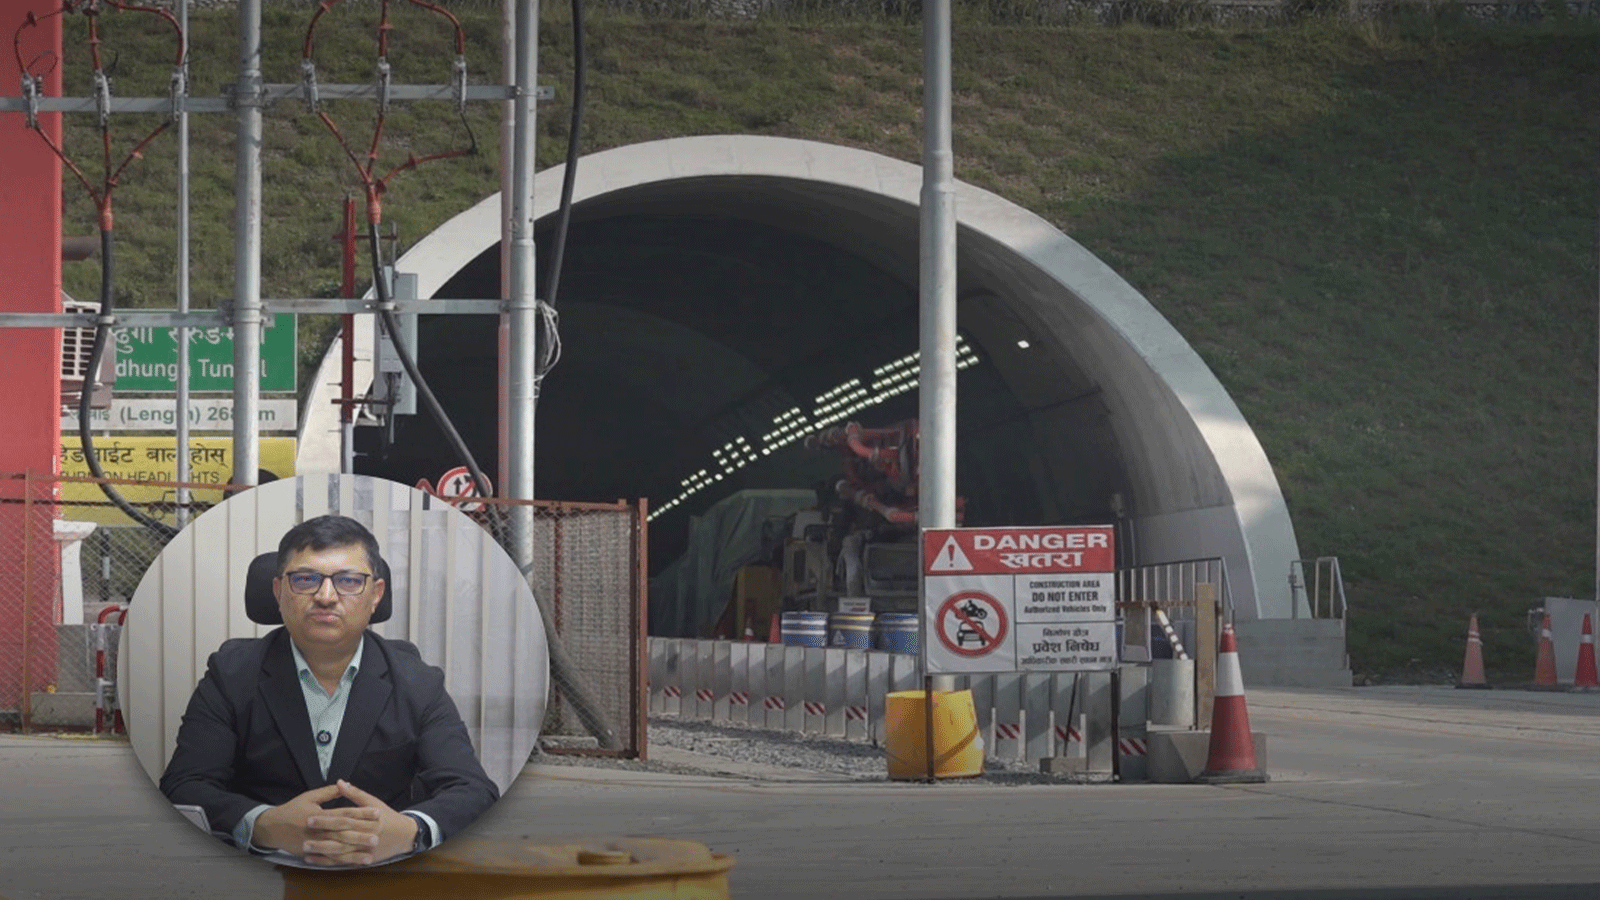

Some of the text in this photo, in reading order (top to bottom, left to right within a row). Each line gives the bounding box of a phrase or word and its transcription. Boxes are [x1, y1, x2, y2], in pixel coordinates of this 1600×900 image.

[197, 358, 267, 378] Tunl
[974, 533, 1108, 550] DANGER
[999, 551, 1084, 568] खतरा
[1029, 580, 1101, 589] CONSTRUCTION AREA
[1032, 591, 1099, 602] DO NOT ENTER
[1024, 604, 1107, 613] Authorized Vehicles Only
[1032, 639, 1061, 654] प्रवेश
